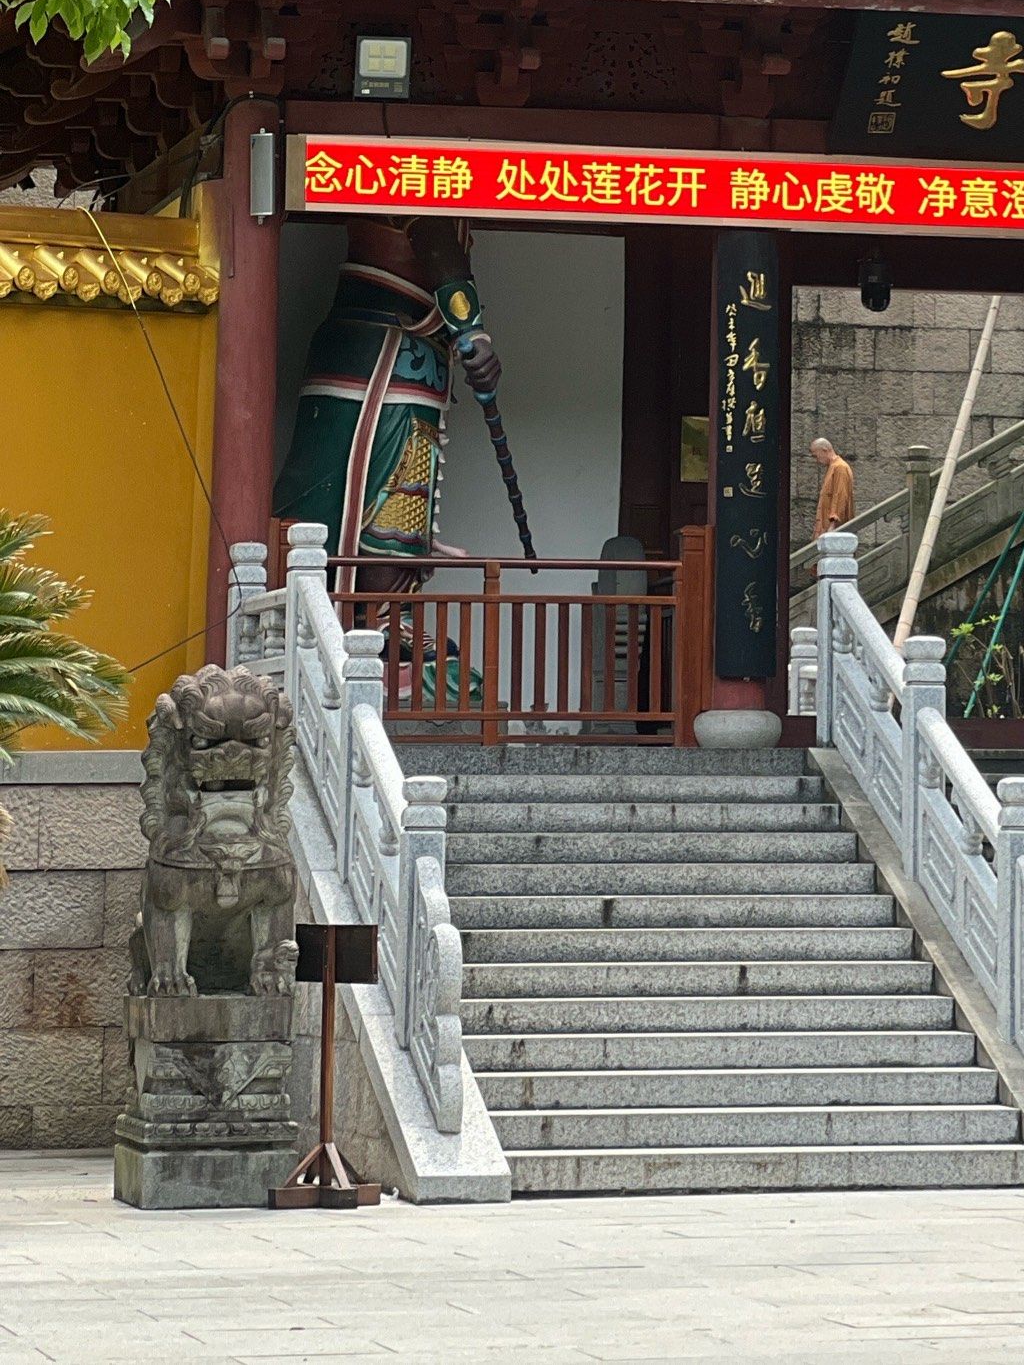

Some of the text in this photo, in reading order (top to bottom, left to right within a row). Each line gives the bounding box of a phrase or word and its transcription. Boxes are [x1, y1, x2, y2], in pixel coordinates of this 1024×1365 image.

[304, 151, 473, 199] 念心清静
[497, 159, 706, 209] 处处莲花开
[730, 167, 895, 215] 静心虔敬
